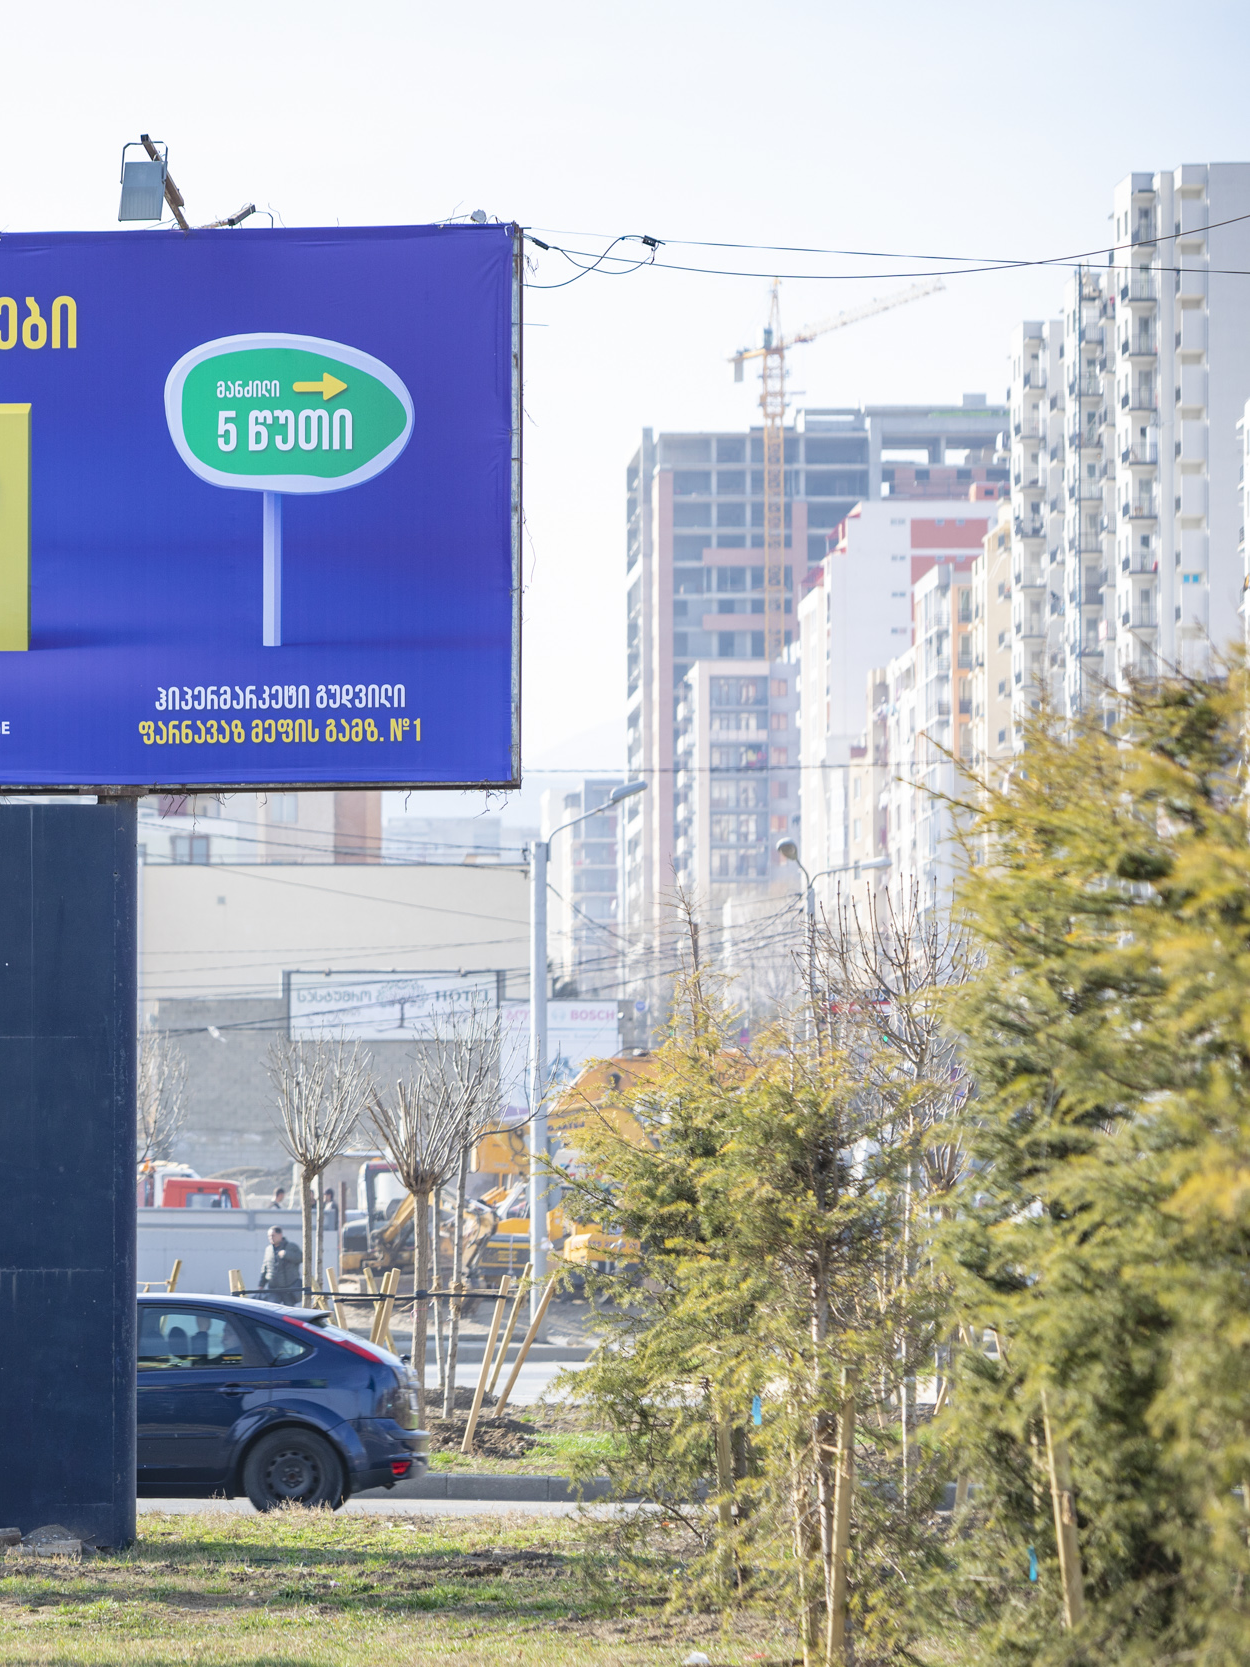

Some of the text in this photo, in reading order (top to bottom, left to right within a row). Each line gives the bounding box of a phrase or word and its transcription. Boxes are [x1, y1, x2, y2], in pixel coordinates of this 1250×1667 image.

[216, 380, 280, 398] მანძილი
[217, 408, 353, 452] 5 წუთი
[155, 683, 406, 711] ჰიპერმარკეტი გუდვილი
[138, 719, 246, 745] ფარნავაზ
[251, 718, 320, 743] მეფის
[325, 717, 385, 742] გამზ.
[570, 1009, 615, 1021] BOSCH
